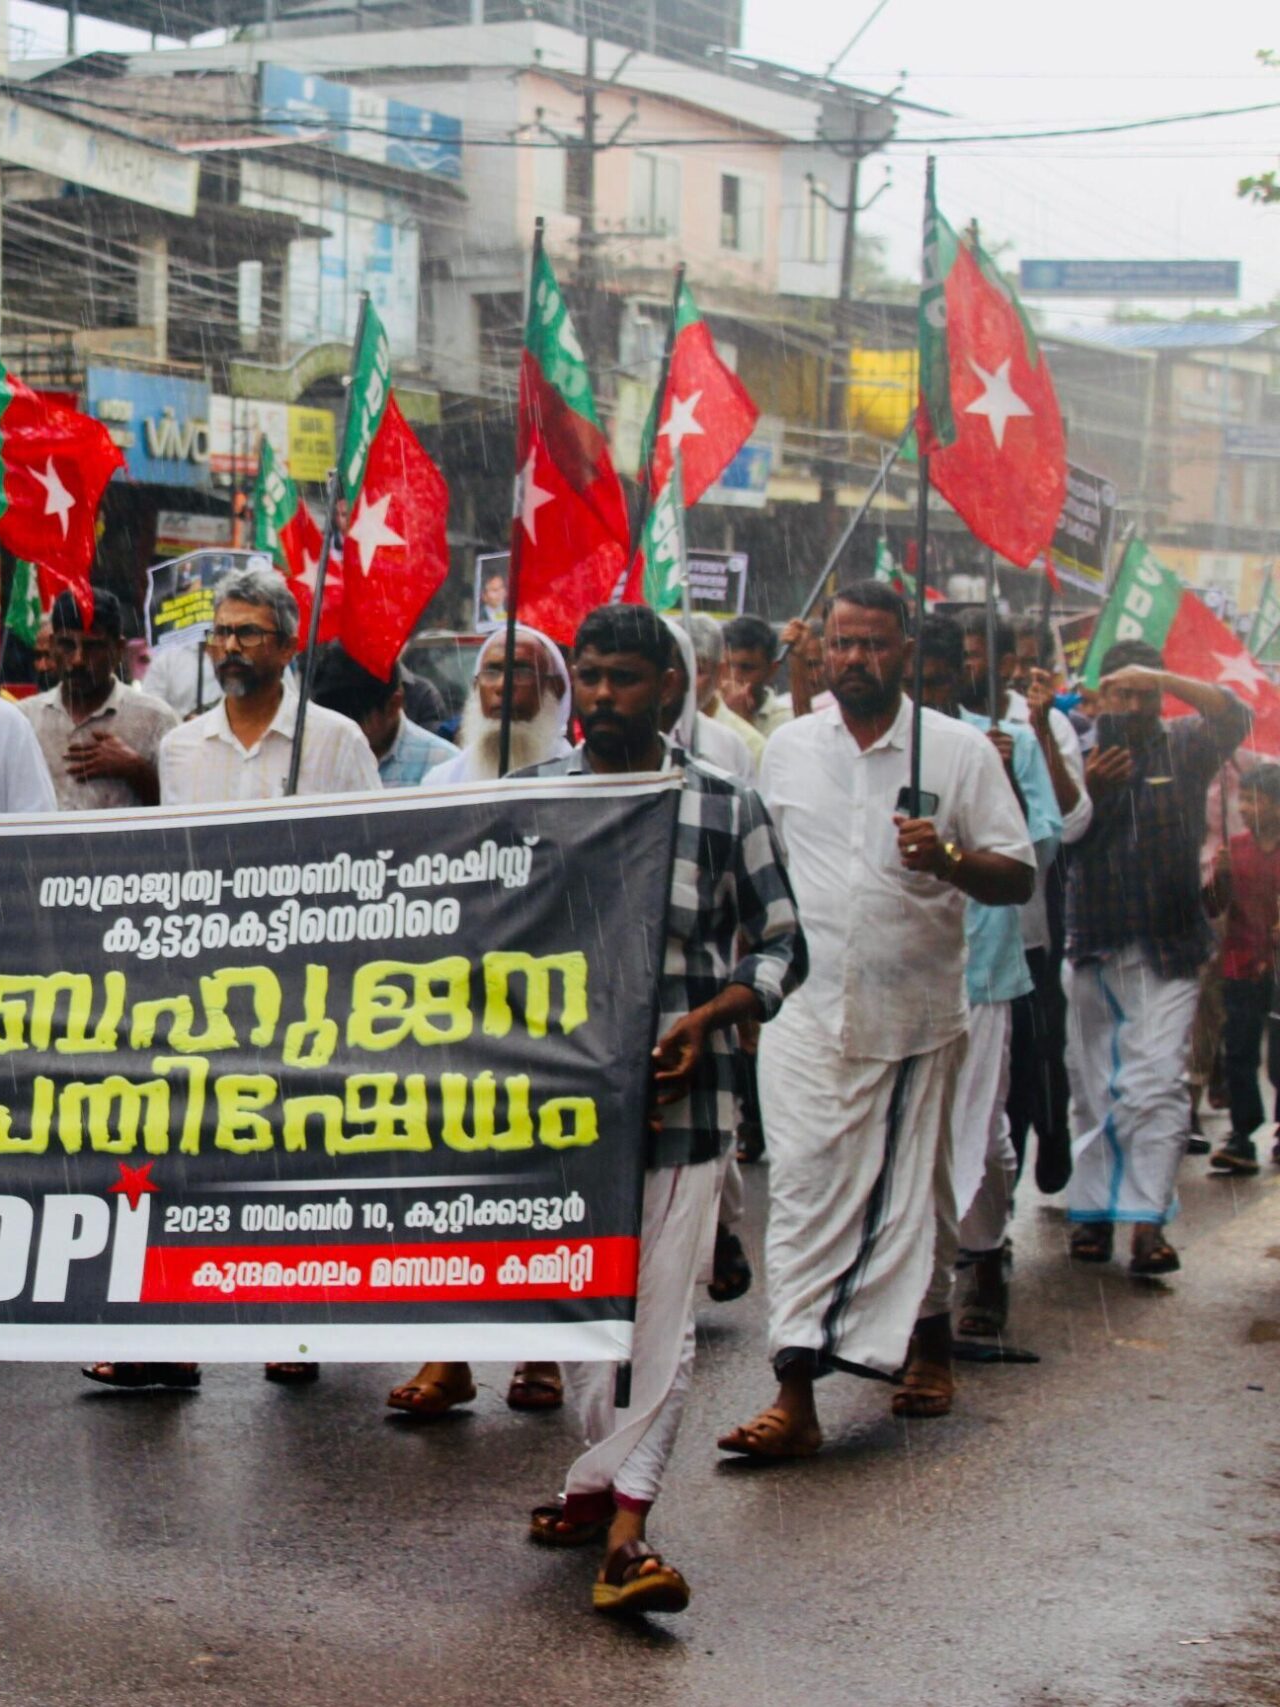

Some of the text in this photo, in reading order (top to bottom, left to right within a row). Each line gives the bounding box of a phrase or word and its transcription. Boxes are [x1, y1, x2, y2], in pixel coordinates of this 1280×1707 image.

[103, 892, 461, 960] കൂട്ടുകെട്ടിനെതിരെ
[164, 1191, 585, 1233] 2023 നവംബർ 10, കുറ്റിക്കാട്ടൂർ
[370, 1257, 485, 1287] മണ്ഡലം
[497, 1244, 594, 1292] കമ്മിറ്റി
